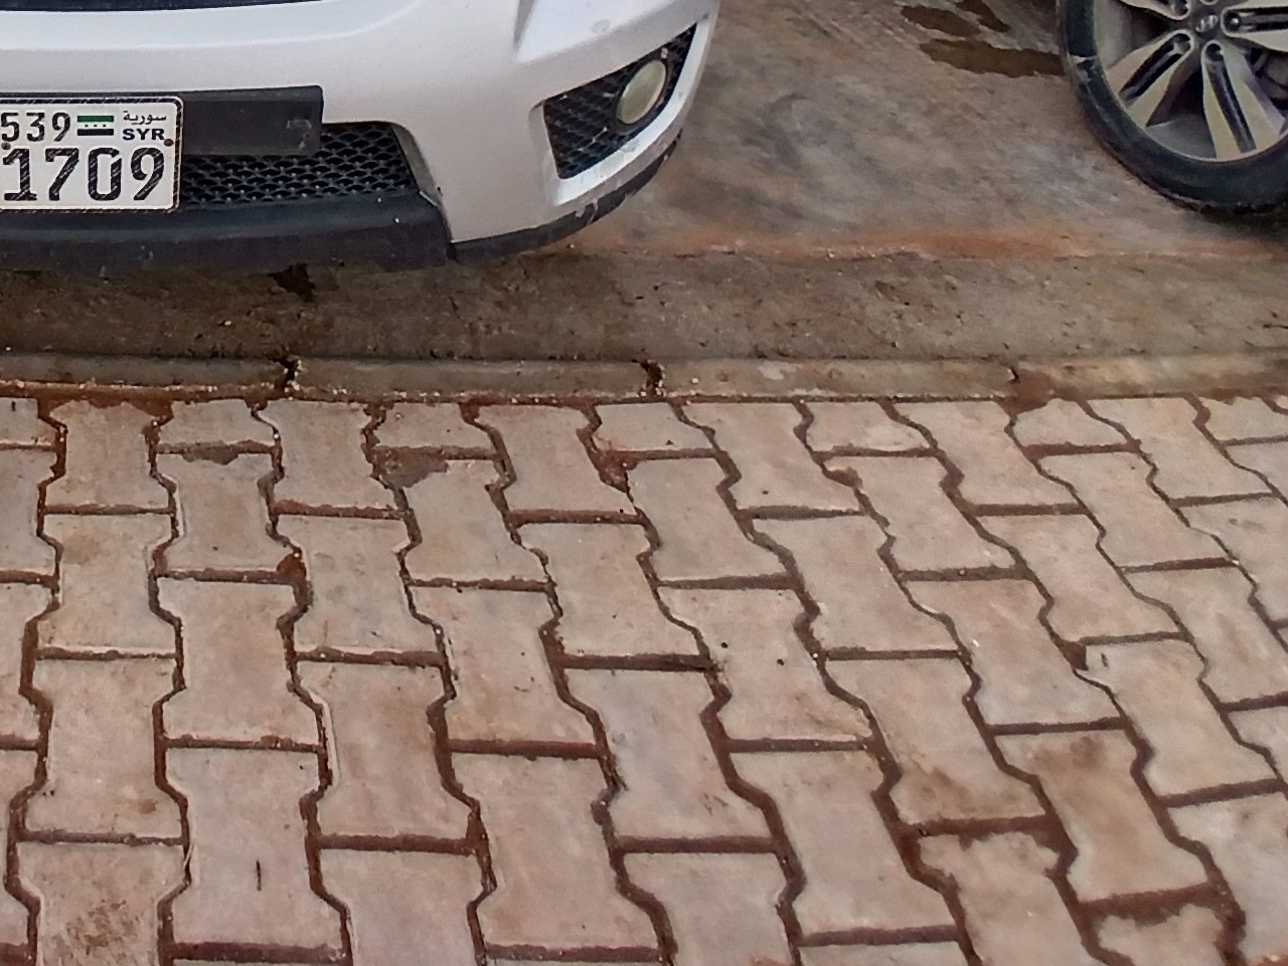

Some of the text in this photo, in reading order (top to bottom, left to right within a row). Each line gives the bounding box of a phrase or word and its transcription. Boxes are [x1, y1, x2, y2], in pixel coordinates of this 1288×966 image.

[0, 112, 71, 142] 539
[122, 110, 167, 126] سورية
[122, 127, 165, 141] SYR
[2, 147, 165, 202] 1709
